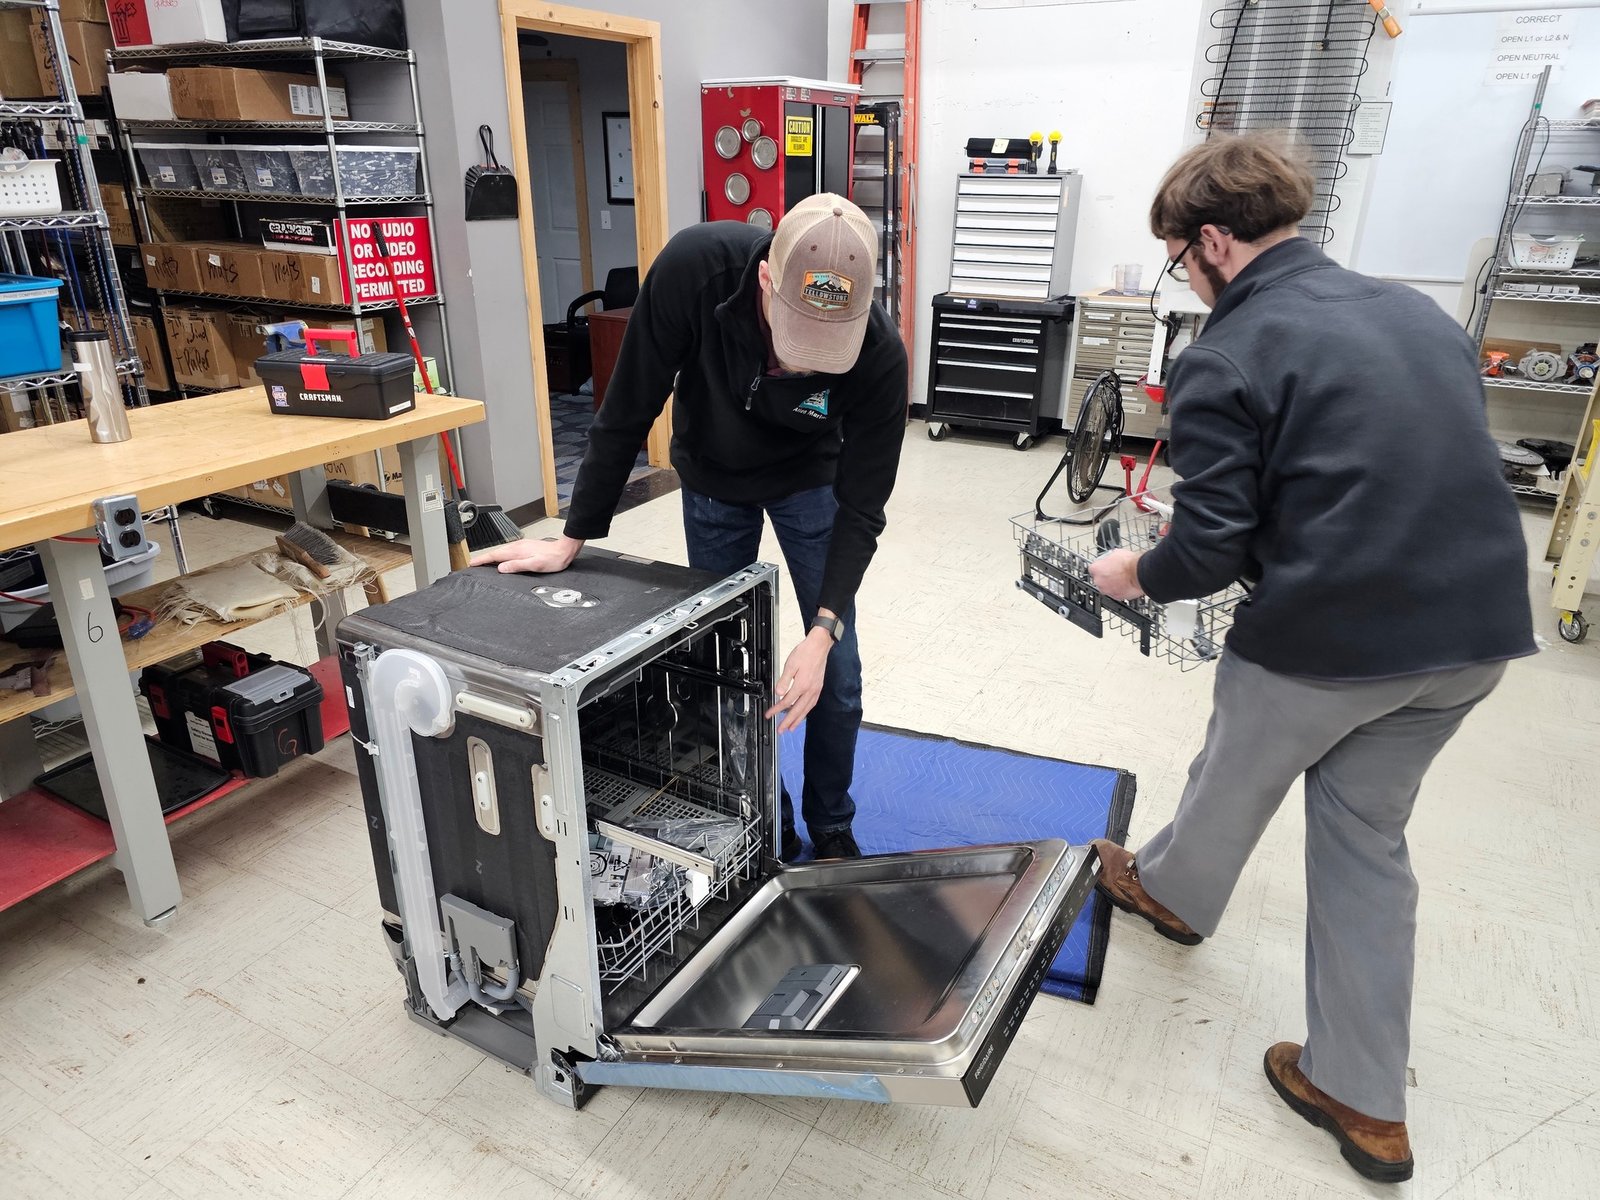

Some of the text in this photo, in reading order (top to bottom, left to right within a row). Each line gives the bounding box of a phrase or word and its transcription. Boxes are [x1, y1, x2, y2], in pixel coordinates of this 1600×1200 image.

[1516, 15, 1562, 24] CORRECT
[1522, 53, 1561, 61] NEUTRAL
[854, 113, 875, 124] WALT
[788, 120, 811, 134] CAUTION
[350, 222, 415, 239] NO UDIO
[353, 243, 375, 259] OR
[355, 278, 426, 298] PERMITED
[805, 289, 848, 301] YELLOWSTONE
[299, 393, 342, 403] CRAFTSMAN
[87, 611, 104, 643] 6
[974, 1044, 994, 1080] FRIGIDAIRE
